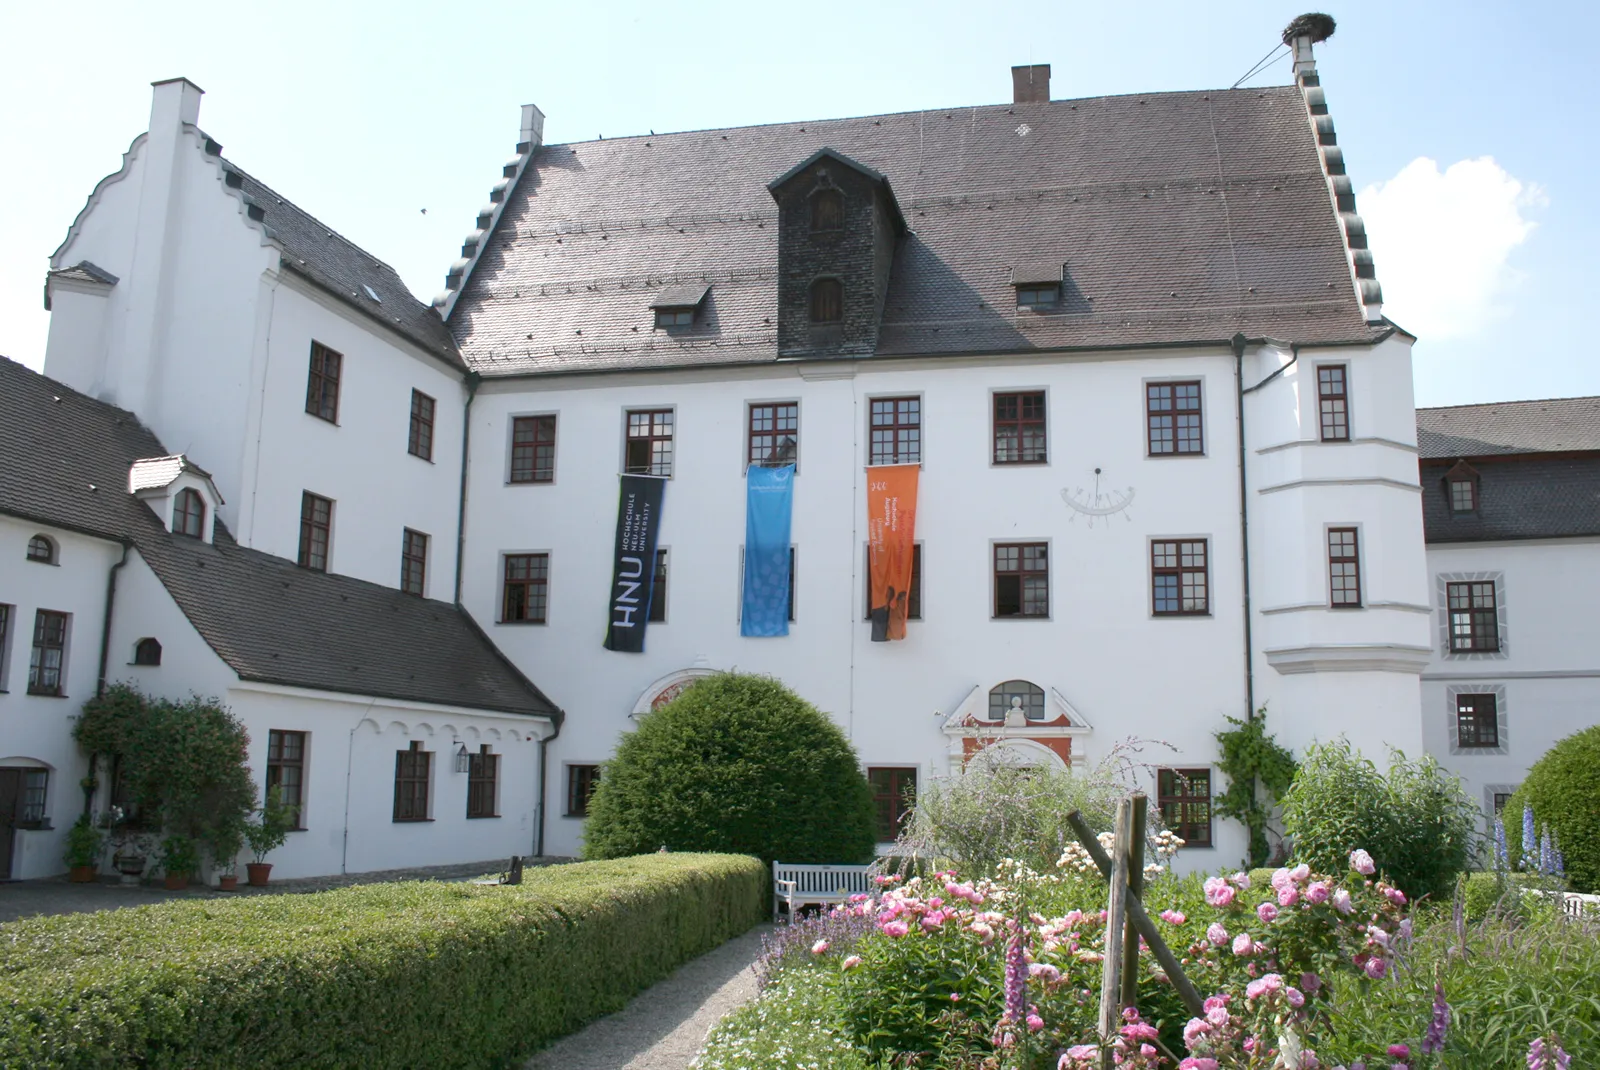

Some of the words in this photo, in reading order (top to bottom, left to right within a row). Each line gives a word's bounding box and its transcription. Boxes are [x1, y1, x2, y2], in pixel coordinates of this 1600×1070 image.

[622, 493, 635, 551] HOCHSCHULE
[631, 514, 641, 551] NEU-ULM
[639, 502, 650, 552] UNIVERSITY
[612, 556, 642, 628] HNU
